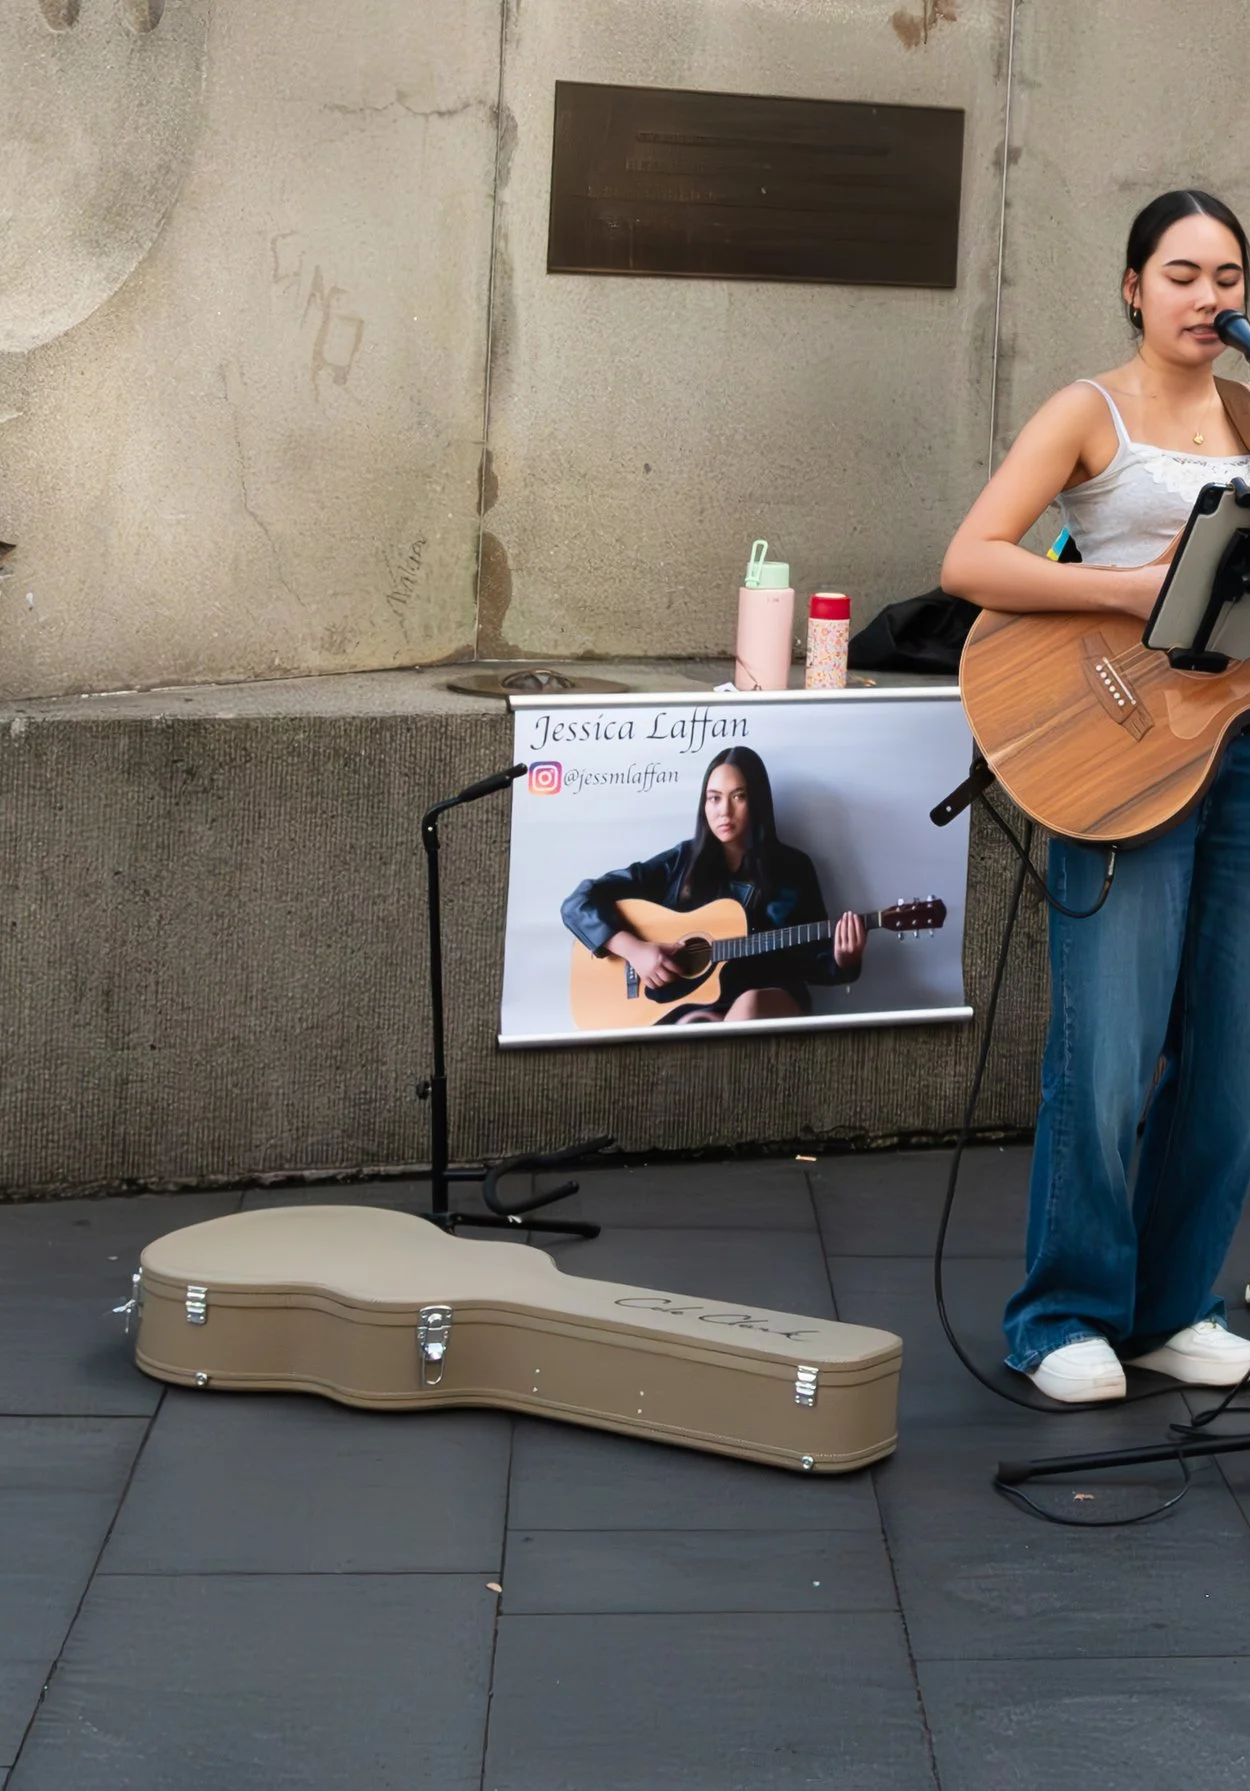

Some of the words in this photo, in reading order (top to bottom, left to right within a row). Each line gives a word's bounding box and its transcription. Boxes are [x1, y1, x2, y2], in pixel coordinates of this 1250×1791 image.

[530, 713, 635, 750] Jessica
[646, 706, 749, 754] Laffan
[563, 762, 679, 795] @jessmlaffan
